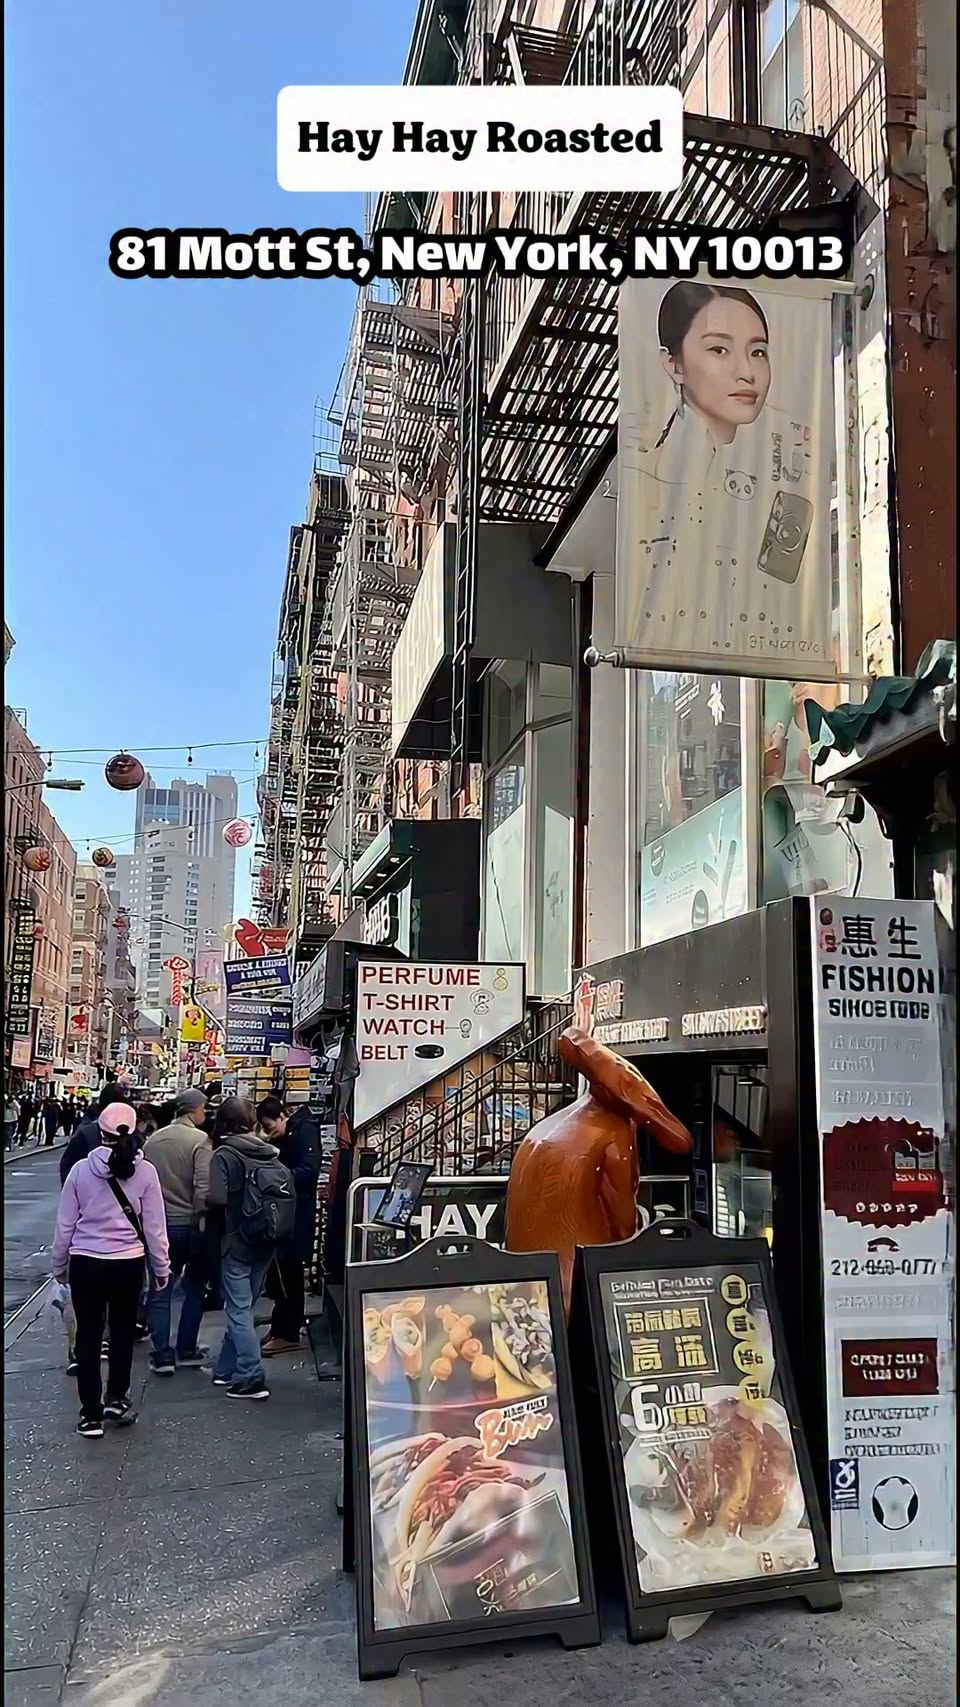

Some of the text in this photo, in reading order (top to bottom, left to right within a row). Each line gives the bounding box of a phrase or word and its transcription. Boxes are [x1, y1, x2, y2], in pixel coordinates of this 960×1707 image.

[840, 913, 922, 959] 惠生
[361, 966, 481, 986] PERFUME
[362, 993, 455, 1011] T-SHIRT
[362, 1018, 445, 1036] WATCH
[361, 1044, 409, 1060] BELT
